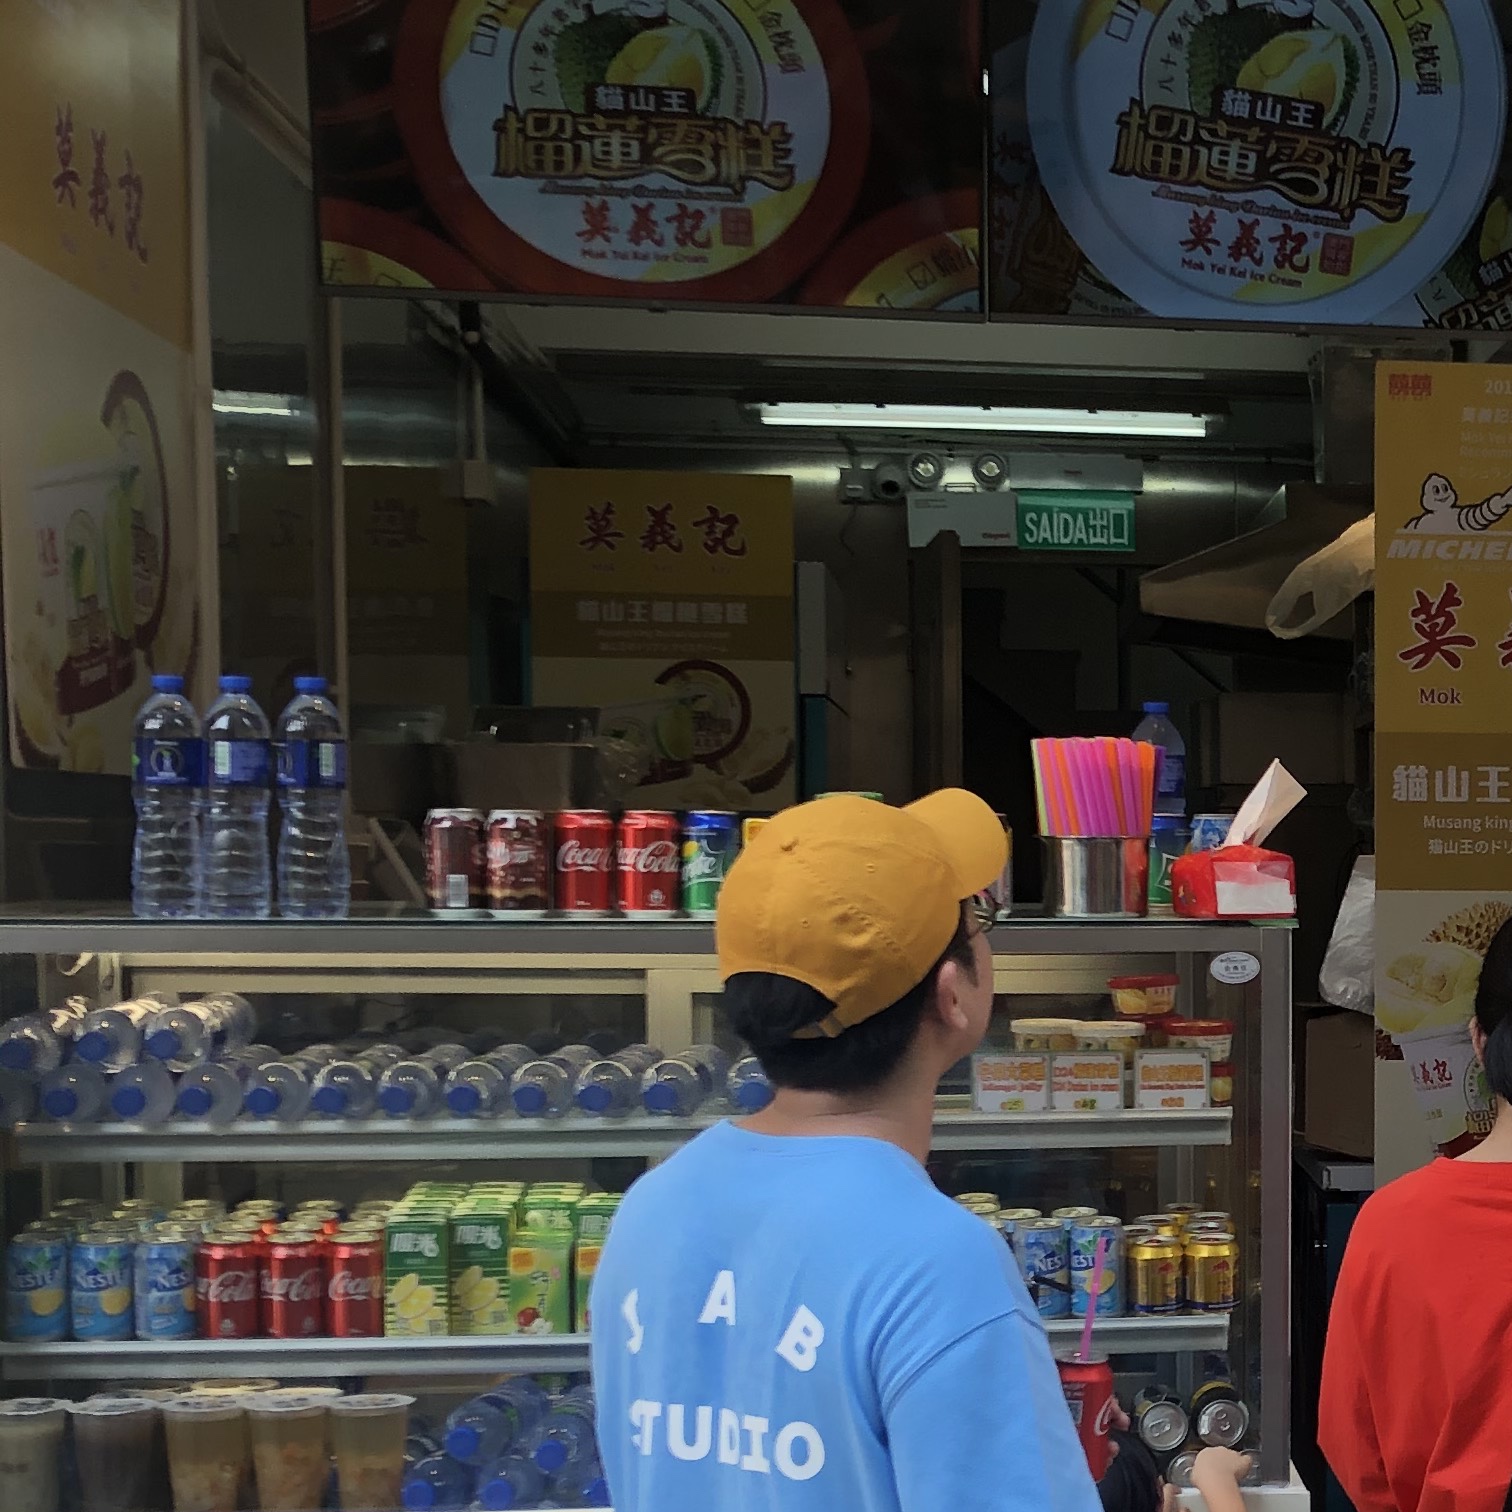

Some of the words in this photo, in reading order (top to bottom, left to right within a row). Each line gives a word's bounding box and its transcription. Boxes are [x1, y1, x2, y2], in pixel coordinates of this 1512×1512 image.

[1219, 88, 1318, 130] 貓山王
[1109, 97, 1416, 225] 榴蓮雪糕
[576, 200, 713, 249] 莫義記
[1179, 209, 1311, 273] 莫義記
[580, 500, 748, 558] 莫義記
[1088, 508, 1129, 546] 出口
[1419, 687, 1462, 705] Mok
[1423, 815, 1482, 832] Musang
